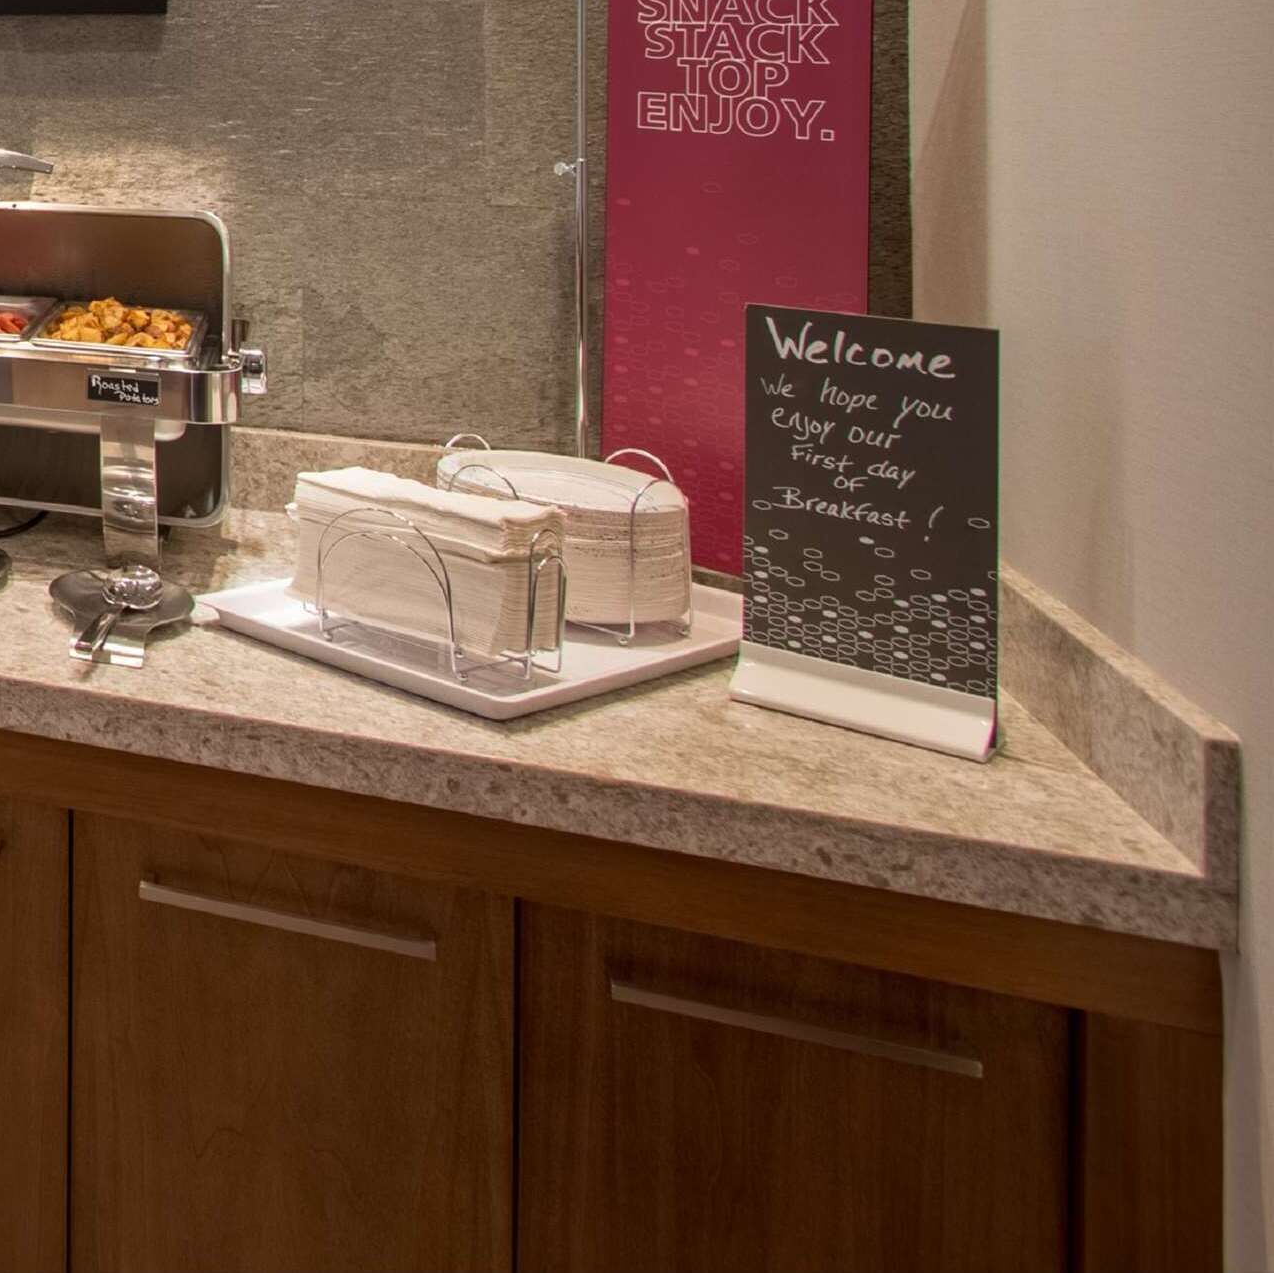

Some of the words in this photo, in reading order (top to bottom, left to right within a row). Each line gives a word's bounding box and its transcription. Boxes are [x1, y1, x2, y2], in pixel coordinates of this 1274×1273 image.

[645, 21, 831, 65] STACK
[677, 57, 789, 99] TOP
[637, 91, 835, 142] ENJOY.
[765, 316, 956, 379] Welcome
[91, 374, 140, 396] Roasted
[760, 374, 797, 398] We
[820, 377, 879, 413] hope
[892, 396, 952, 429] you
[771, 406, 836, 444] enjoy
[848, 425, 902, 449] our
[791, 443, 855, 473] First
[867, 460, 916, 489] day
[771, 486, 912, 529] Breakfast
